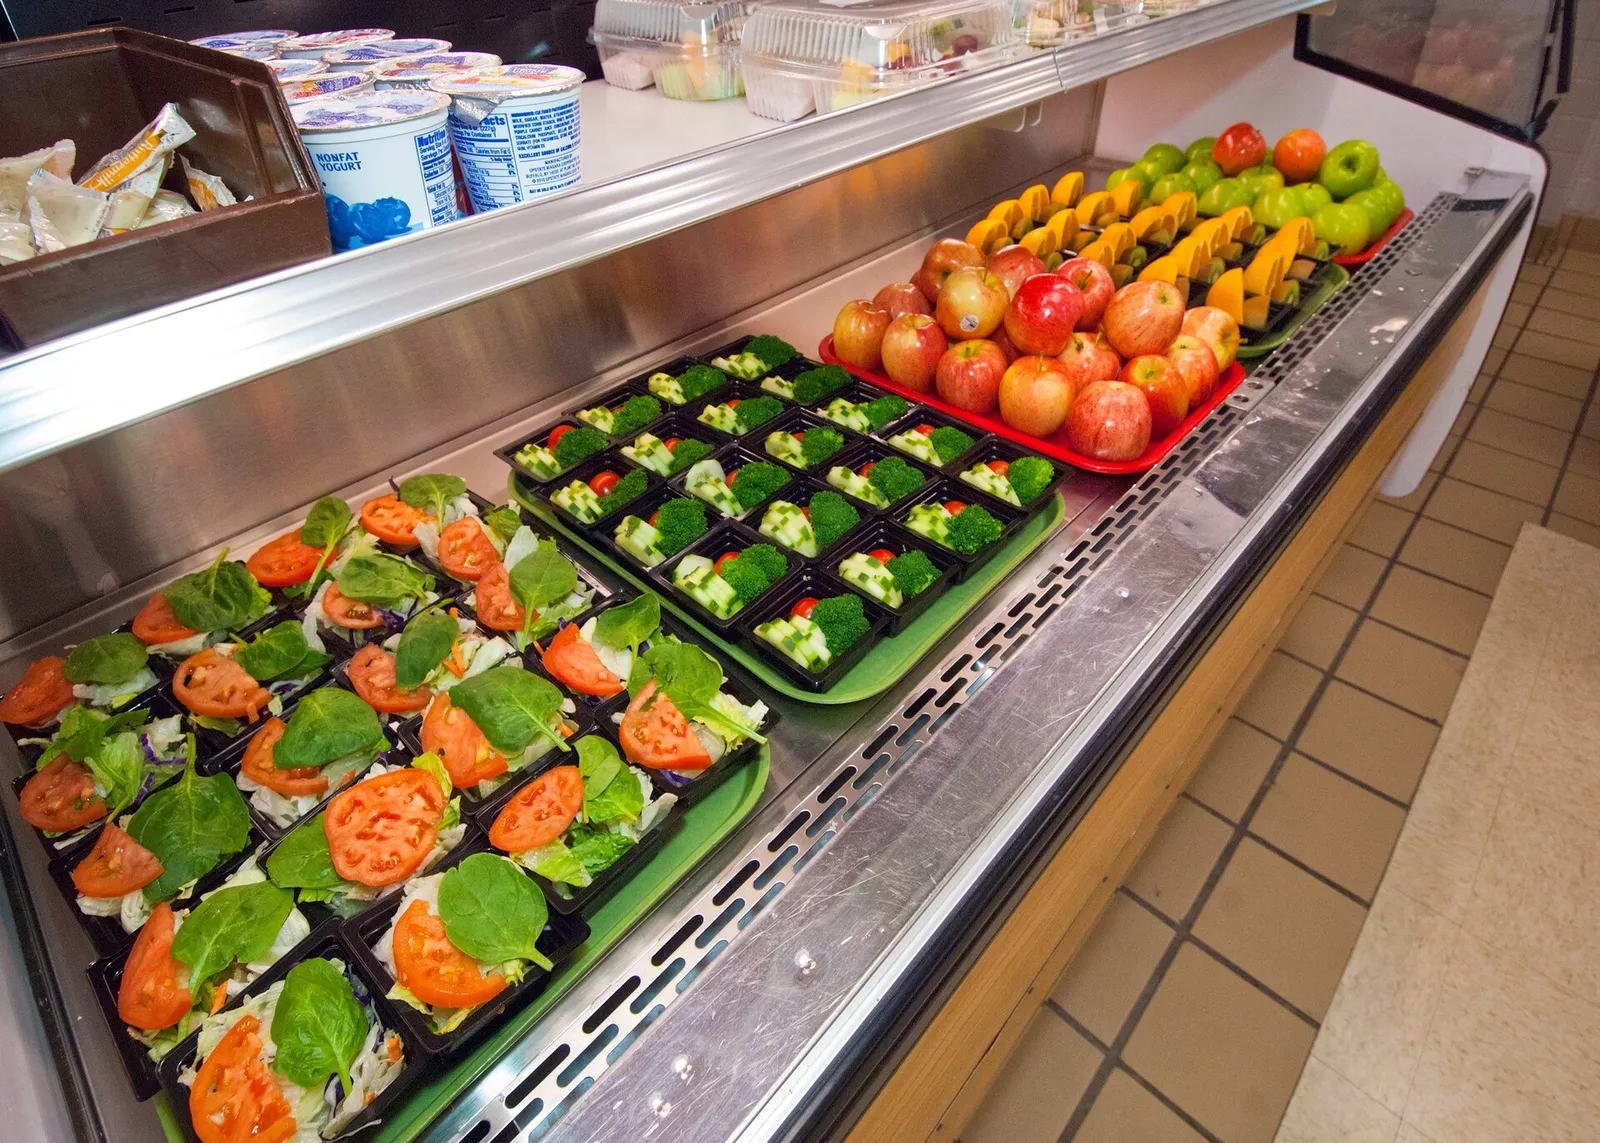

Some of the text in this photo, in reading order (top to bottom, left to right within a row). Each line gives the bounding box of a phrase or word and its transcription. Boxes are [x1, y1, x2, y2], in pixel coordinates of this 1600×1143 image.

[96, 139, 154, 187] Buttermilk
[316, 152, 359, 163] NONFAT
[319, 161, 362, 172] YOGURT
